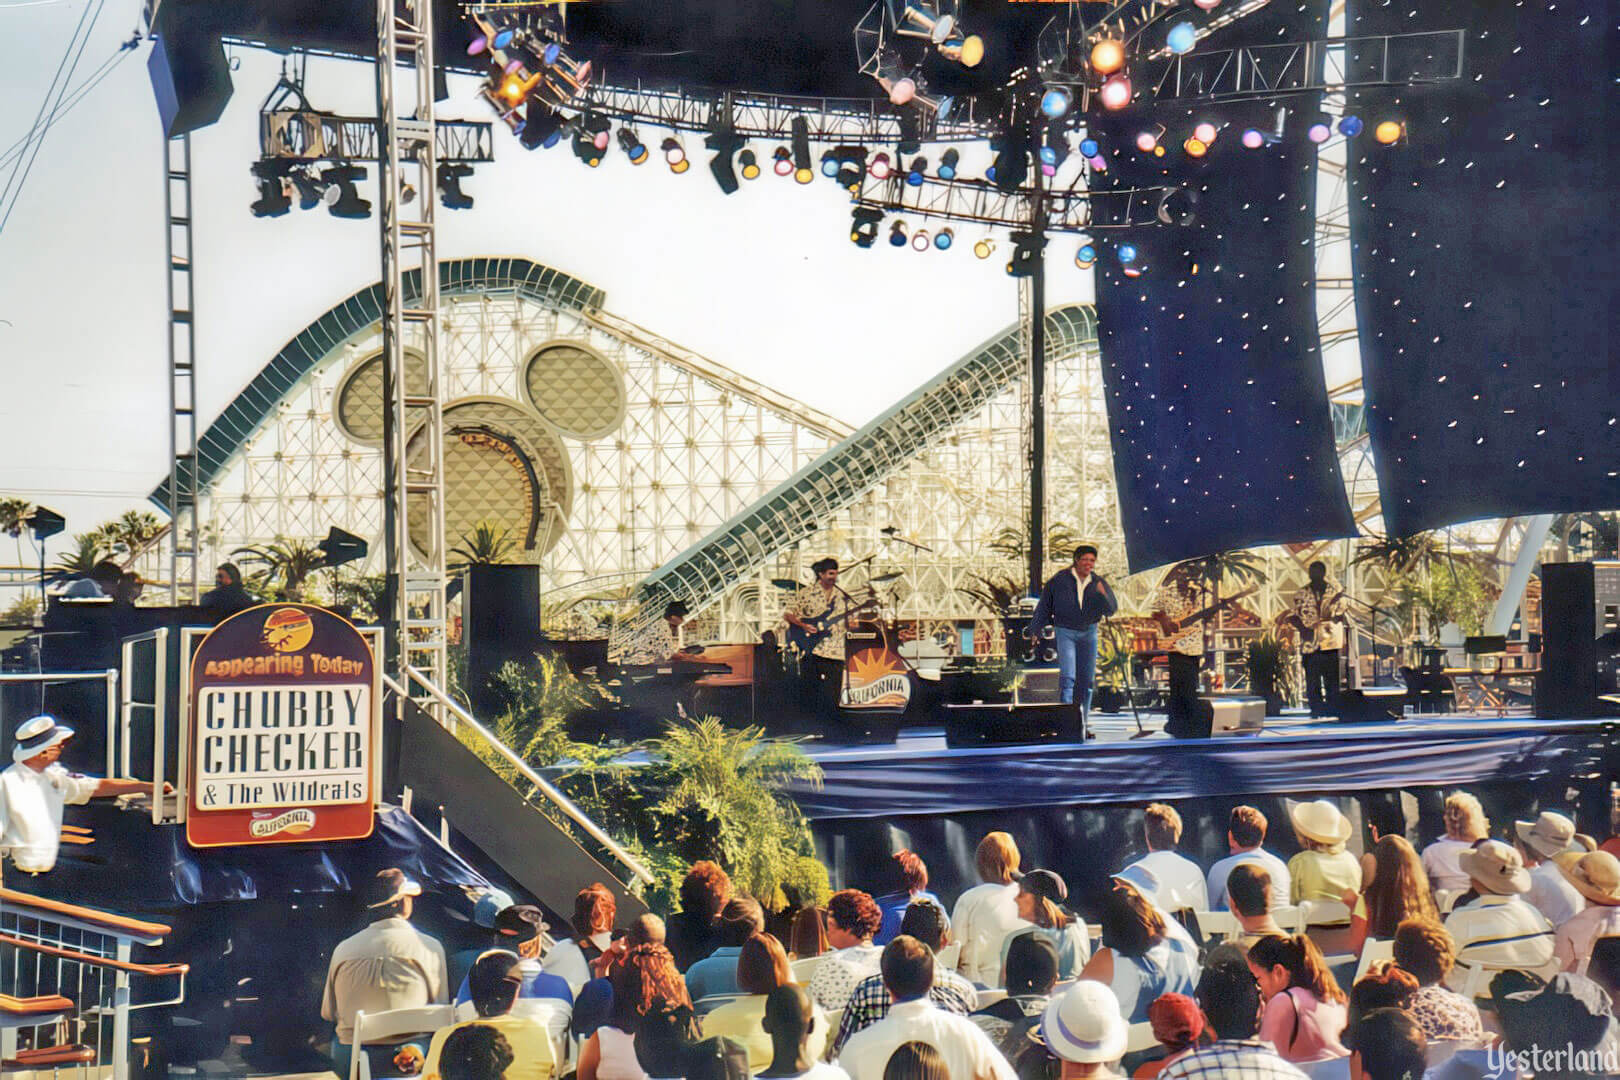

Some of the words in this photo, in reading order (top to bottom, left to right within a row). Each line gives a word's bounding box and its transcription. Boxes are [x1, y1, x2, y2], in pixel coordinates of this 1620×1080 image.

[205, 652, 304, 677] Appearing
[310, 653, 364, 676] Today
[206, 689, 362, 729] CHUBBY
[204, 732, 362, 773] CHECKER
[203, 783, 217, 806] &
[226, 783, 263, 804] The
[272, 780, 363, 802] Wildcats
